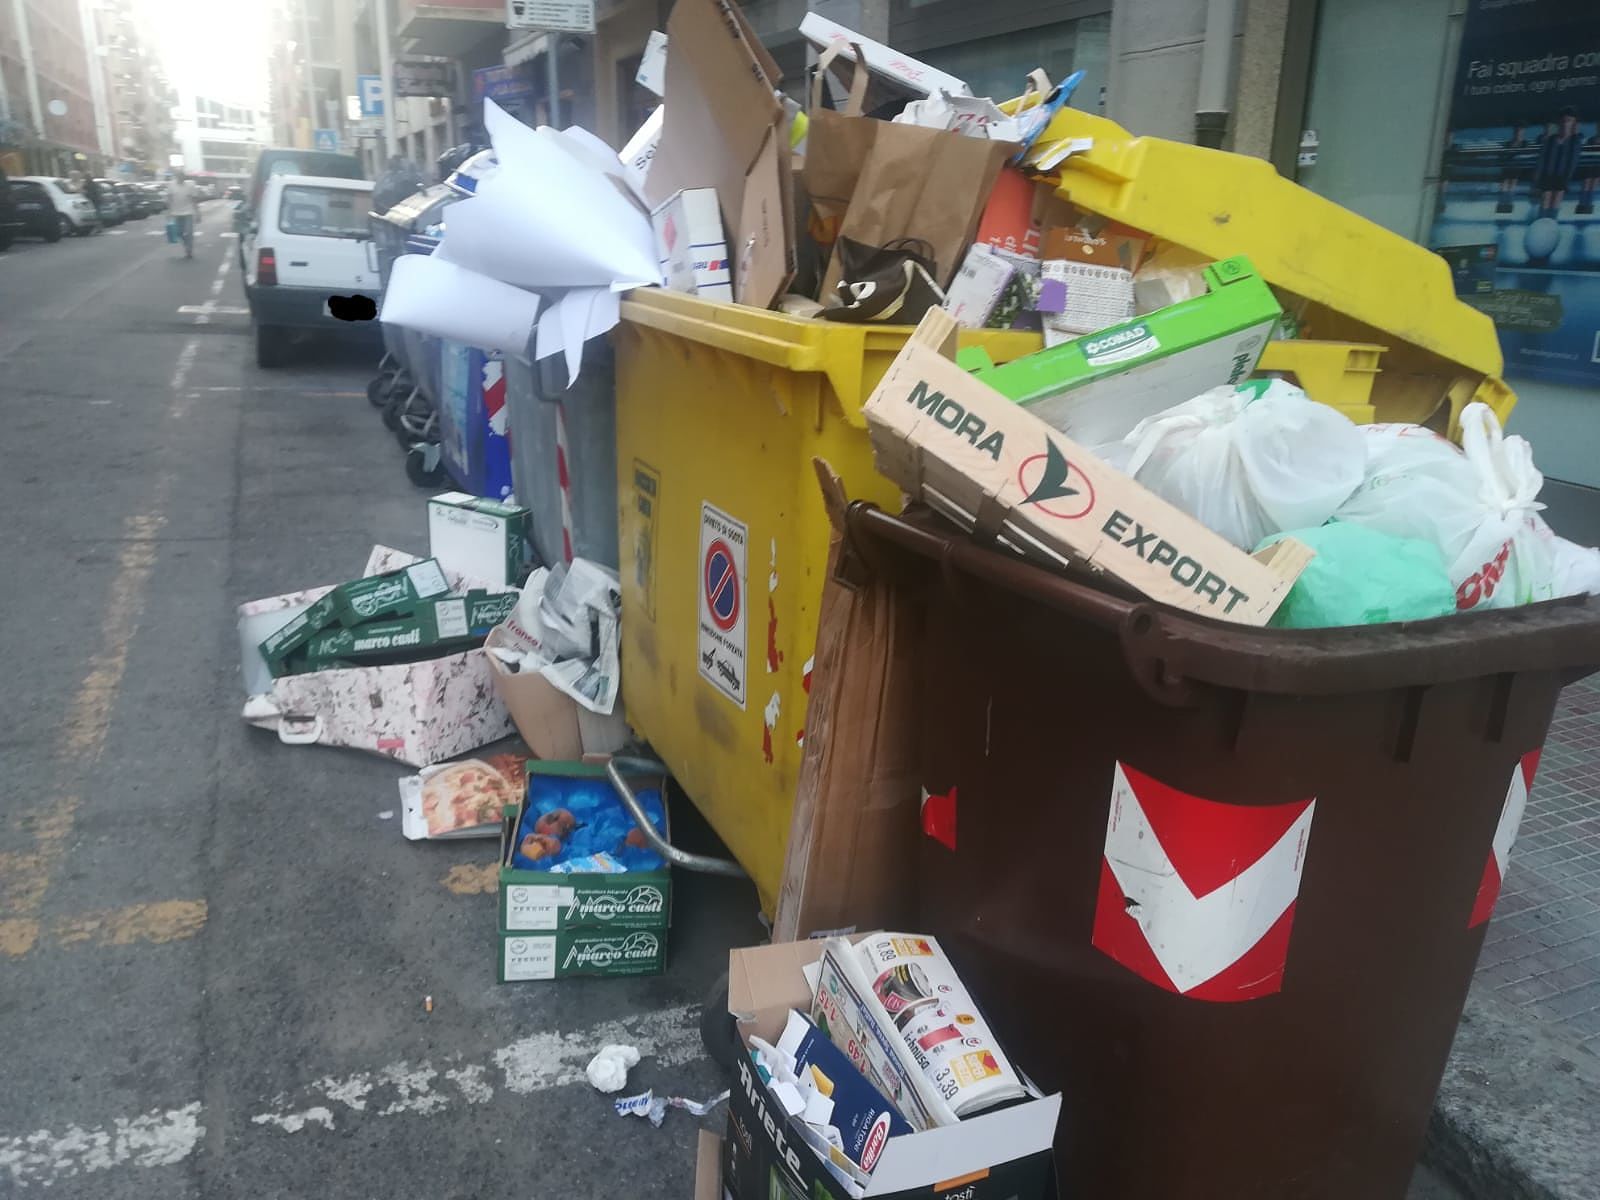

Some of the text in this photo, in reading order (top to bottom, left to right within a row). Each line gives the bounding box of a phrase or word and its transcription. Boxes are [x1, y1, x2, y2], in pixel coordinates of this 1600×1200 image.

[1468, 59, 1494, 79] Fai
[1496, 53, 1569, 79] squadra
[1101, 326, 1146, 348] CONAD
[906, 380, 1005, 462] MORA
[1100, 509, 1250, 615] EXPORT
[354, 634, 390, 651] marco
[578, 898, 662, 914] marco casti
[576, 944, 657, 962] marco casti
[935, 1067, 960, 1101] 3,39
[855, 1107, 876, 1153] RIGATONI
[862, 1123, 886, 1170] Barilla
